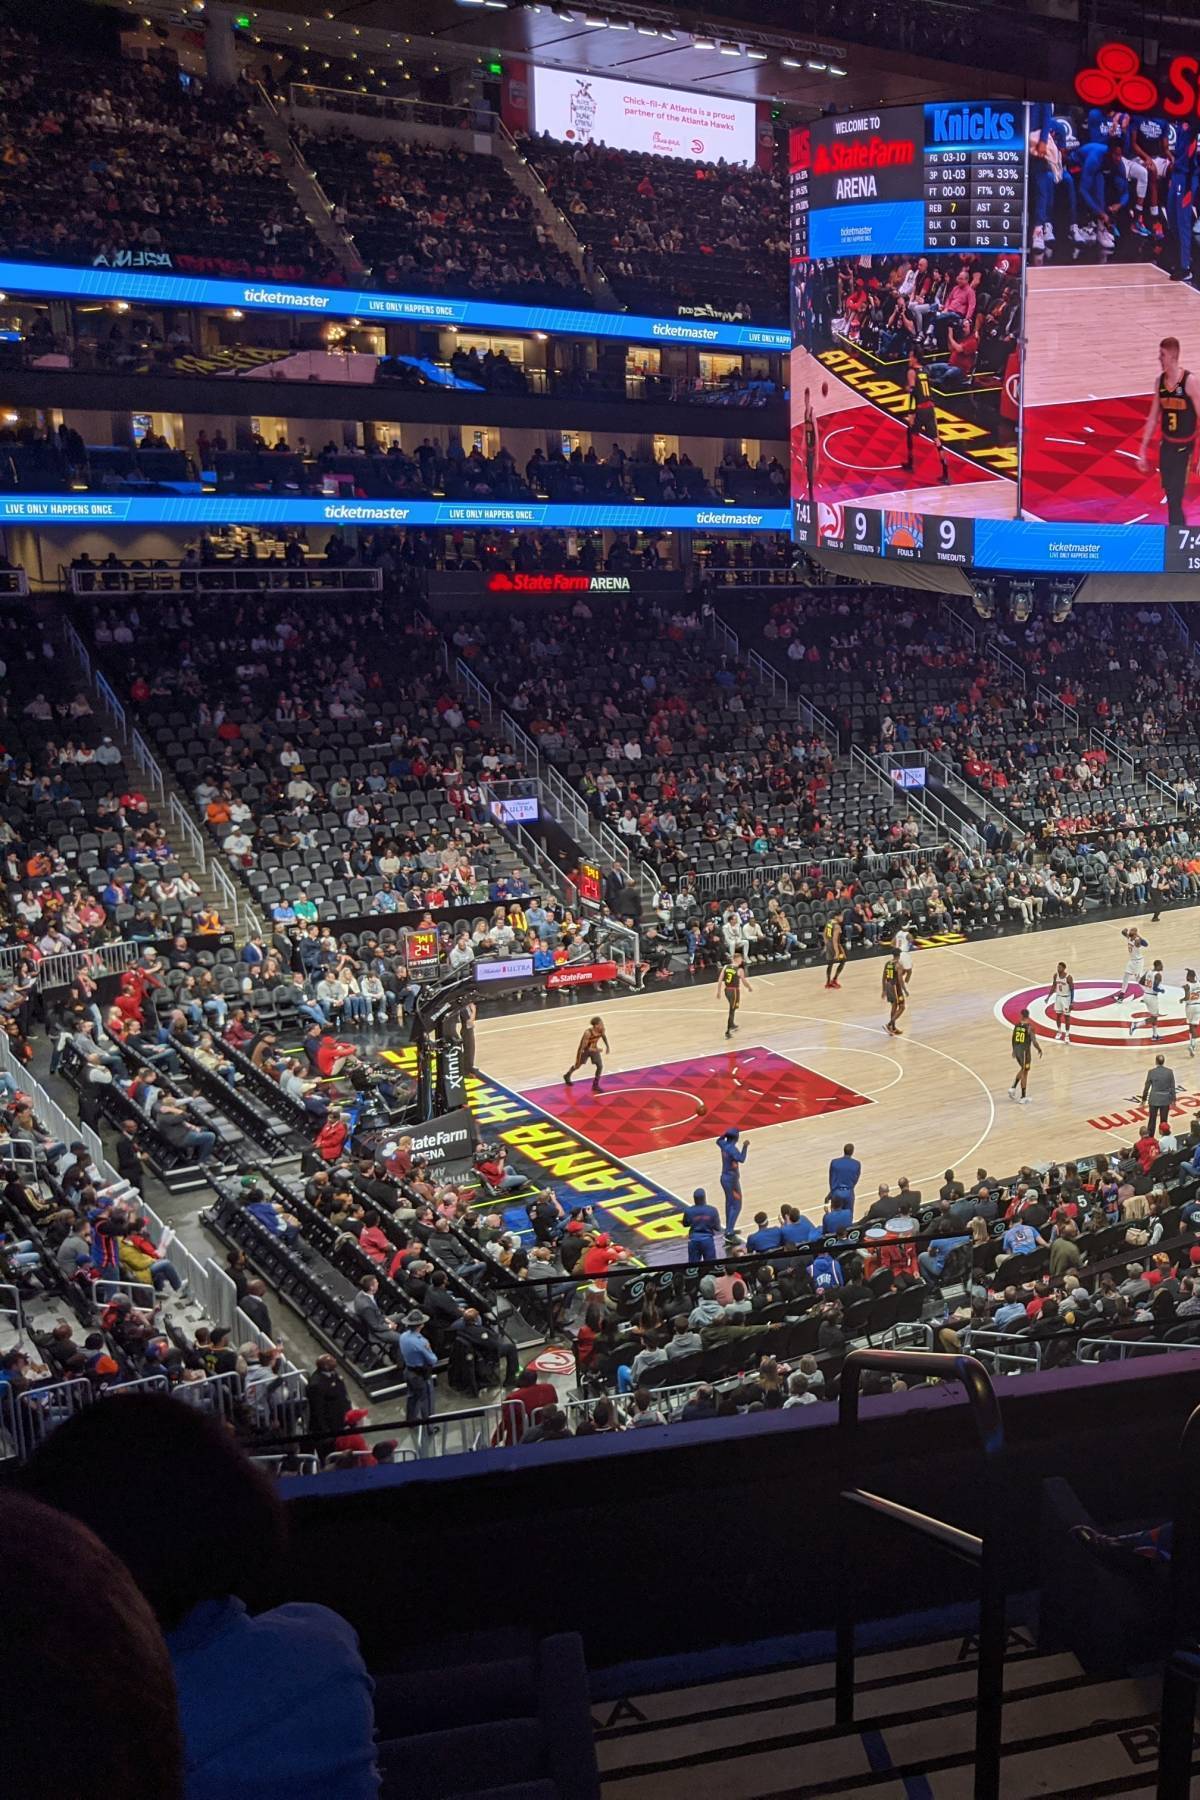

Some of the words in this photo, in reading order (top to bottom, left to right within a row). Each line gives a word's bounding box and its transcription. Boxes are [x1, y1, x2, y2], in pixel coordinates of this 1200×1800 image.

[624, 107, 655, 119] partner
[657, 111, 665, 120] of
[667, 112, 680, 122] the
[681, 115, 709, 128] Atlanta
[710, 119, 735, 131] Hawks
[670, 103, 698, 115] Atlanta
[699, 106, 705, 116] is
[712, 110, 735, 121] proud
[835, 118, 869, 134] WELCOME
[869, 116, 881, 129] TO
[934, 107, 1014, 142] Knicks
[929, 154, 938, 162] FG
[943, 152, 966, 162] 03-10
[977, 152, 994, 160] FG%
[997, 151, 1019, 161] 30%
[929, 171, 938, 180] 3P
[942, 169, 966, 180] 01-03
[977, 169, 994, 178] 3P%
[996, 169, 1019, 179] 33%
[836, 175, 878, 200] ARENA
[929, 187, 937, 196] FT
[942, 186, 966, 196] 00-00
[977, 186, 993, 195] FT%
[999, 186, 1015, 196] 0%
[929, 204, 942, 213] REB
[950, 203, 957, 213] 7
[976, 203, 991, 212] AST
[1003, 203, 1010, 213] 2
[929, 220, 942, 229] BLK
[950, 219, 957, 230] 0
[976, 219, 991, 229] STL
[1002, 219, 1010, 230] 0
[928, 236, 937, 246] TO
[950, 236, 956, 246] 0
[976, 236, 990, 245] FLS
[1003, 236, 1008, 246] 1
[243, 287, 330, 308] ticketmaster
[369, 300, 385, 310] LIVE
[386, 302, 403, 312] ONLY
[404, 303, 434, 315] HAPPENS
[652, 322, 719, 340] ticketmaster
[748, 333, 761, 342] LIVE
[761, 334, 776, 343] ONLY
[1167, 412, 1177, 431] 3
[5, 503, 25, 514] LIVE
[27, 504, 48, 514] ONLY
[51, 504, 89, 515] HAPPENS
[324, 504, 409, 520] ticketmaster
[449, 509, 465, 519] LIVE
[466, 509, 482, 519] ONLY
[484, 509, 515, 520] HAPPENS
[796, 503, 811, 524] 7:41
[696, 510, 763, 526] ticketmaster
[855, 512, 867, 541] 9
[939, 520, 956, 549] 9
[853, 543, 874, 554] TIMEOUTS
[897, 548, 914, 557] FOULS
[1049, 541, 1101, 552] ticketmaster
[937, 552, 966, 563] TIMEOUTS
[590, 577, 631, 590] ARENA
[584, 876, 599, 898] 24
[414, 944, 430, 957] 24
[726, 973, 733, 983] 3
[1015, 1031, 1025, 1043] 20
[445, 1044, 464, 1089] xfinity
[411, 1128, 468, 1151] tateFarm
[500, 1122, 690, 1241] ATLANTA
[1077, 1194, 1088, 1207] 5
